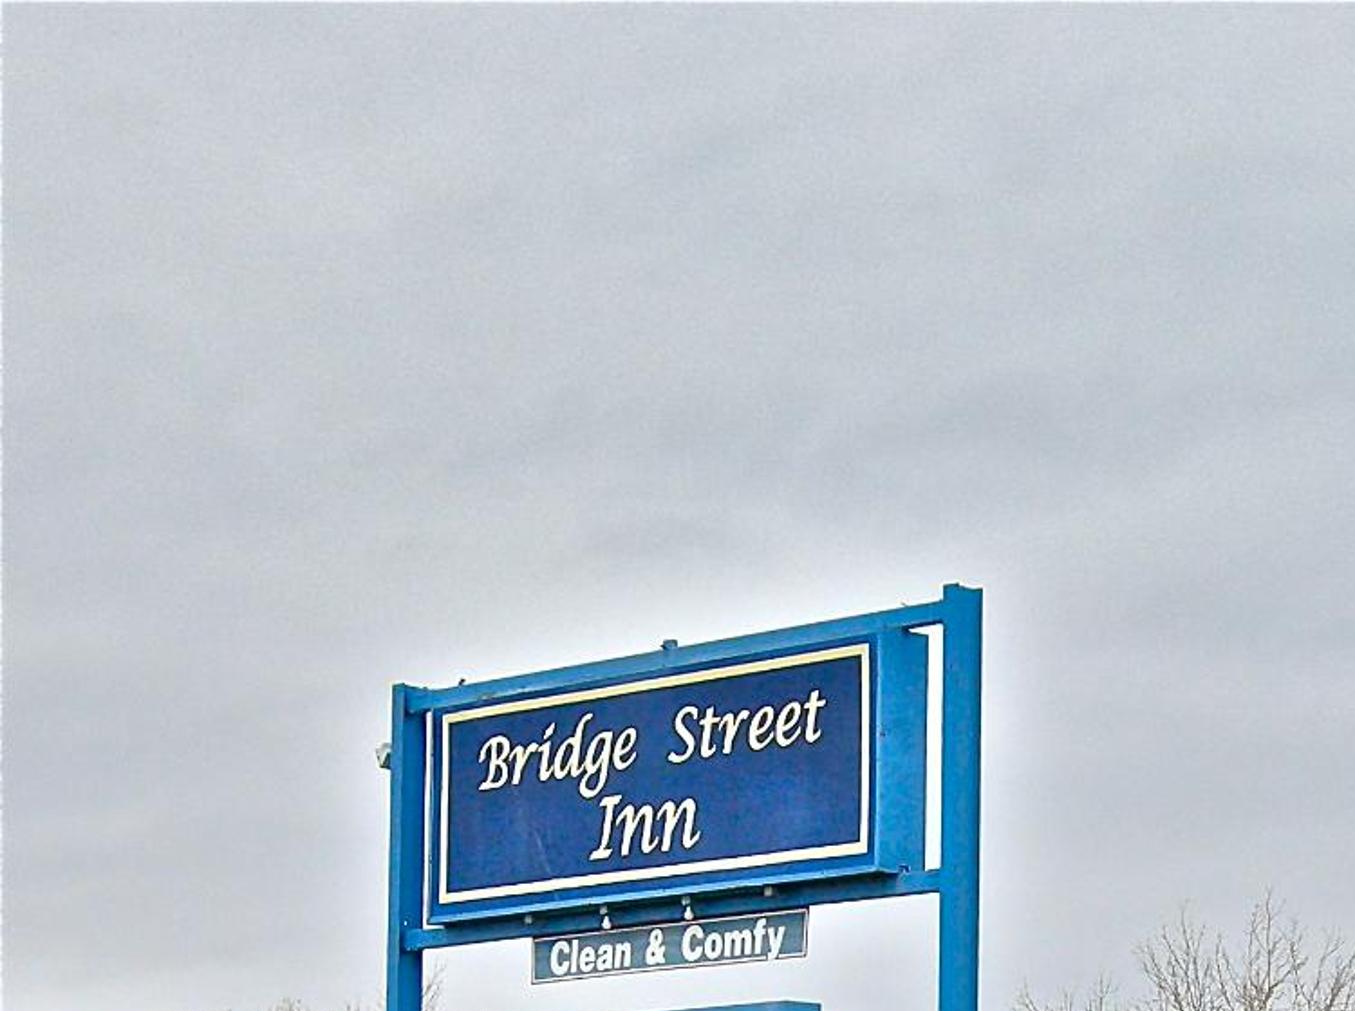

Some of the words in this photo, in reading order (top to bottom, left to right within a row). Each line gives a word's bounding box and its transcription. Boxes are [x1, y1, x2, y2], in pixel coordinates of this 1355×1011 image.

[478, 713, 638, 797] Bridge
[667, 690, 826, 763] Street
[588, 794, 700, 861] Inn
[550, 938, 632, 976] Clean
[645, 928, 666, 964] &
[682, 918, 786, 962] Comfy
